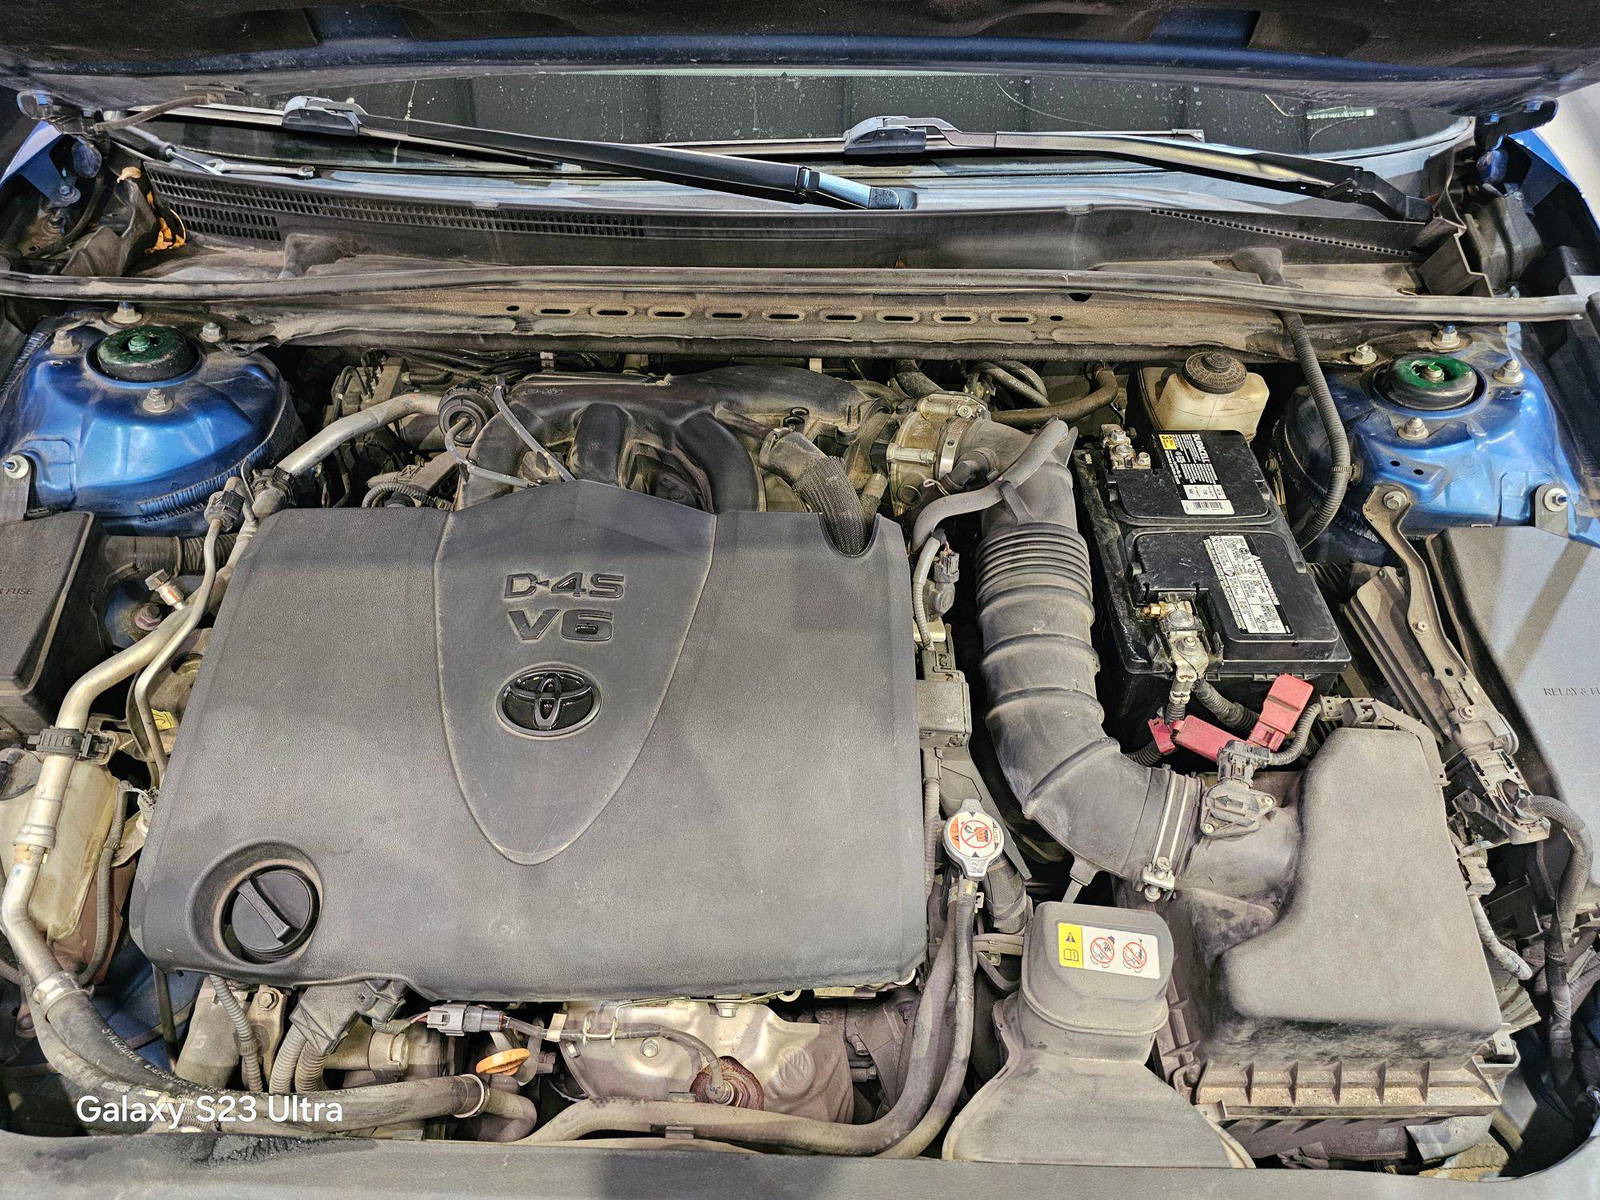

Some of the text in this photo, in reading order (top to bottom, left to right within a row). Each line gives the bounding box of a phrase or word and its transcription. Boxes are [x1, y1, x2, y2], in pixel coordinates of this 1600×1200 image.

[1191, 433, 1211, 464] DURACELL
[504, 571, 625, 599] D-4S
[507, 608, 614, 642] V6
[1543, 687, 1579, 696] RELAY
